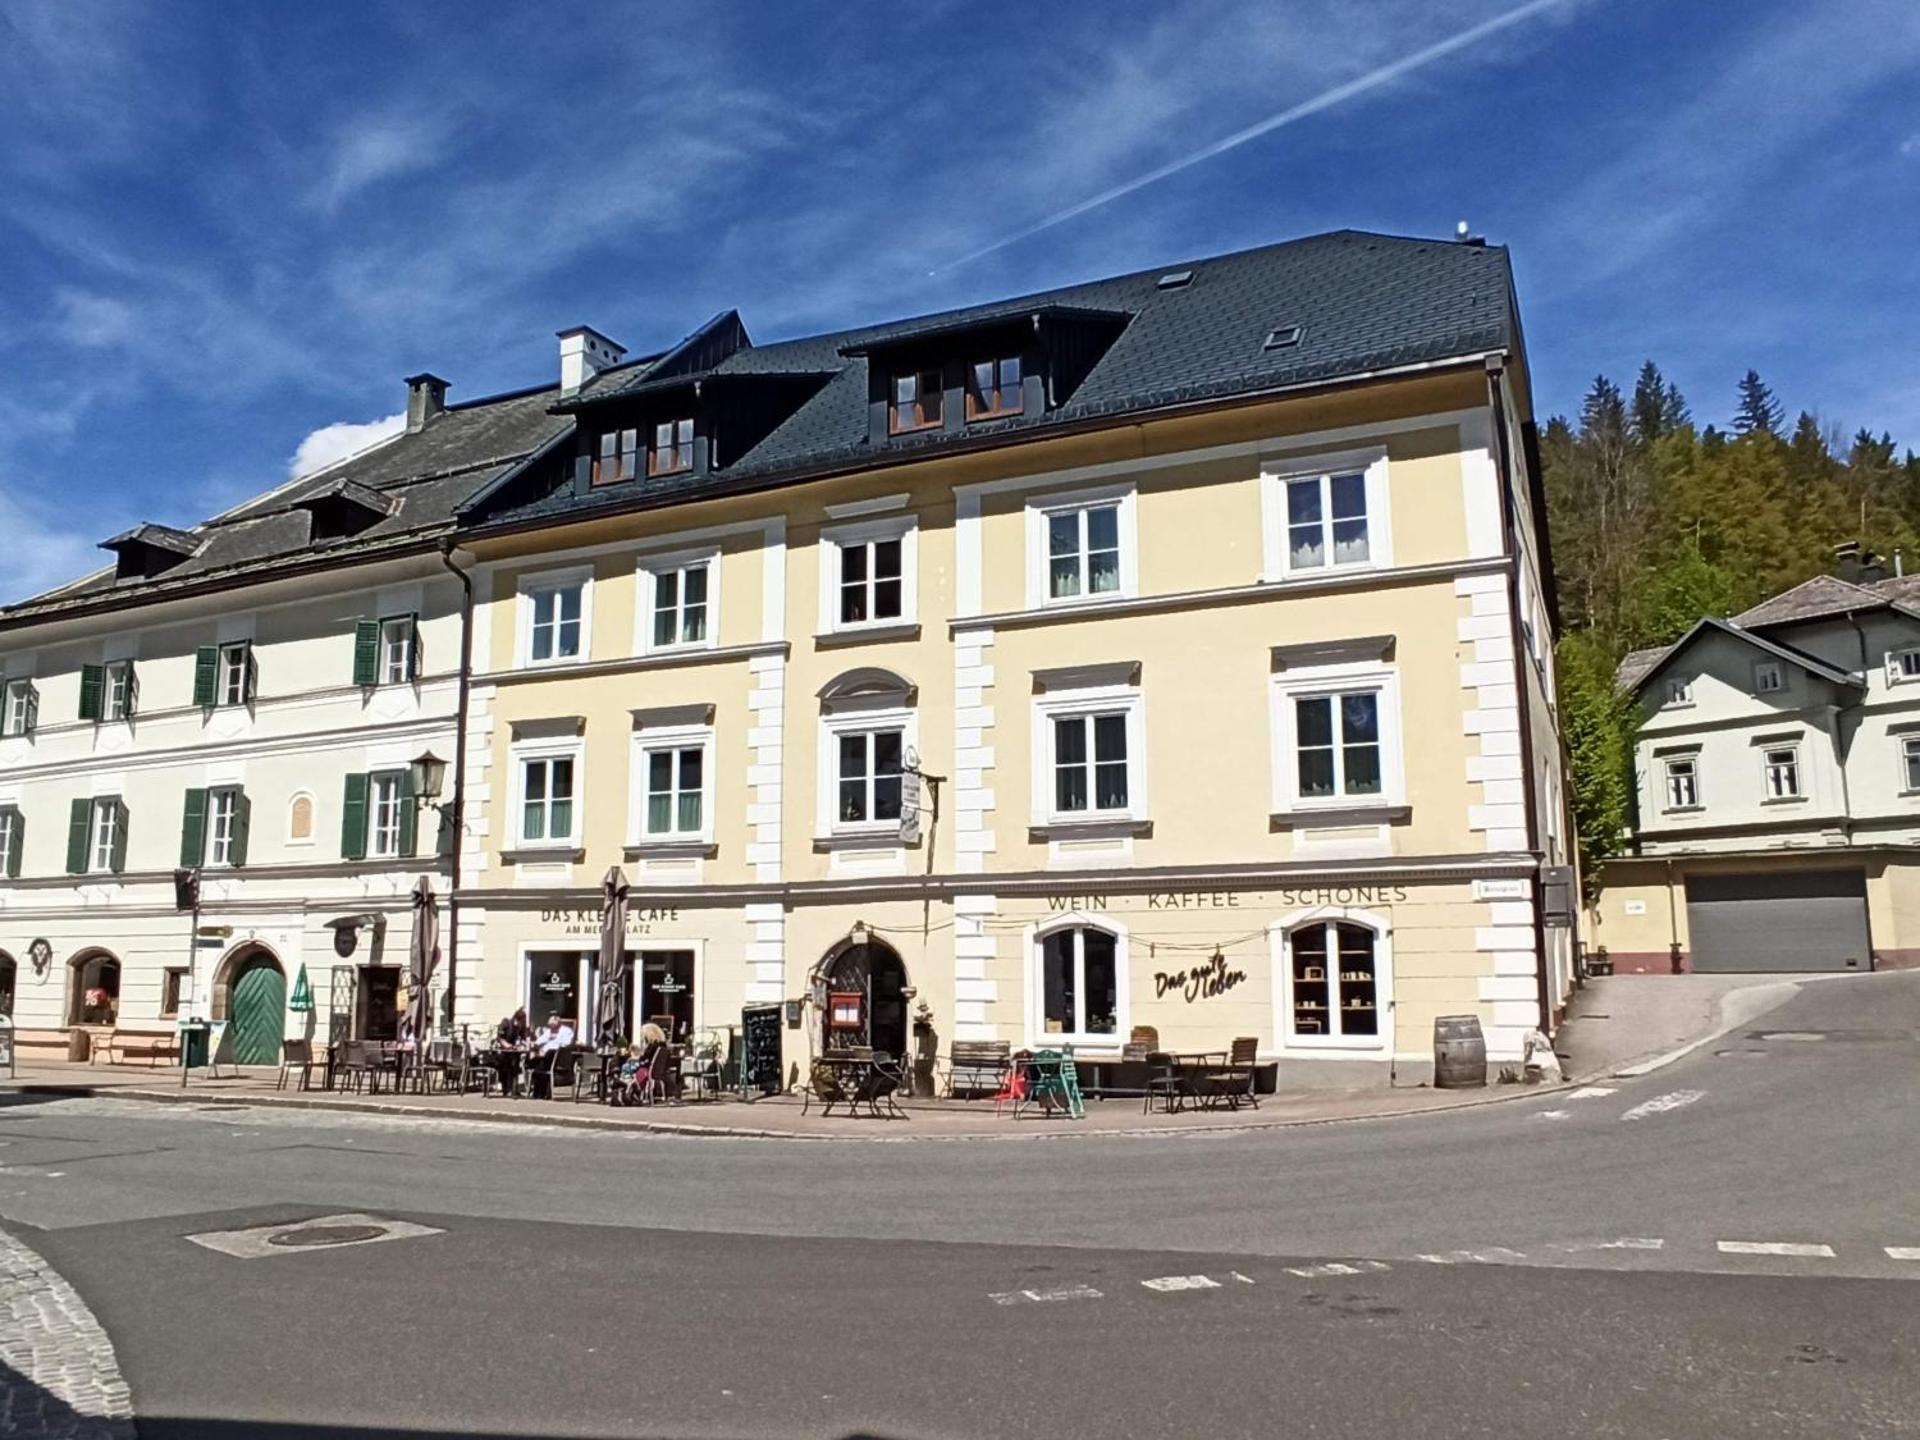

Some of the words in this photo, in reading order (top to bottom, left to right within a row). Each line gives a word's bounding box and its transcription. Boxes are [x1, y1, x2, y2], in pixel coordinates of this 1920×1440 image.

[1048, 895, 1107, 911] WEIN
[1148, 891, 1239, 909] KAFFEE
[541, 909, 571, 922] DAS
[577, 908, 631, 922] KLEE
[1154, 972, 1187, 999] Das
[1184, 952, 1227, 1003] gute
